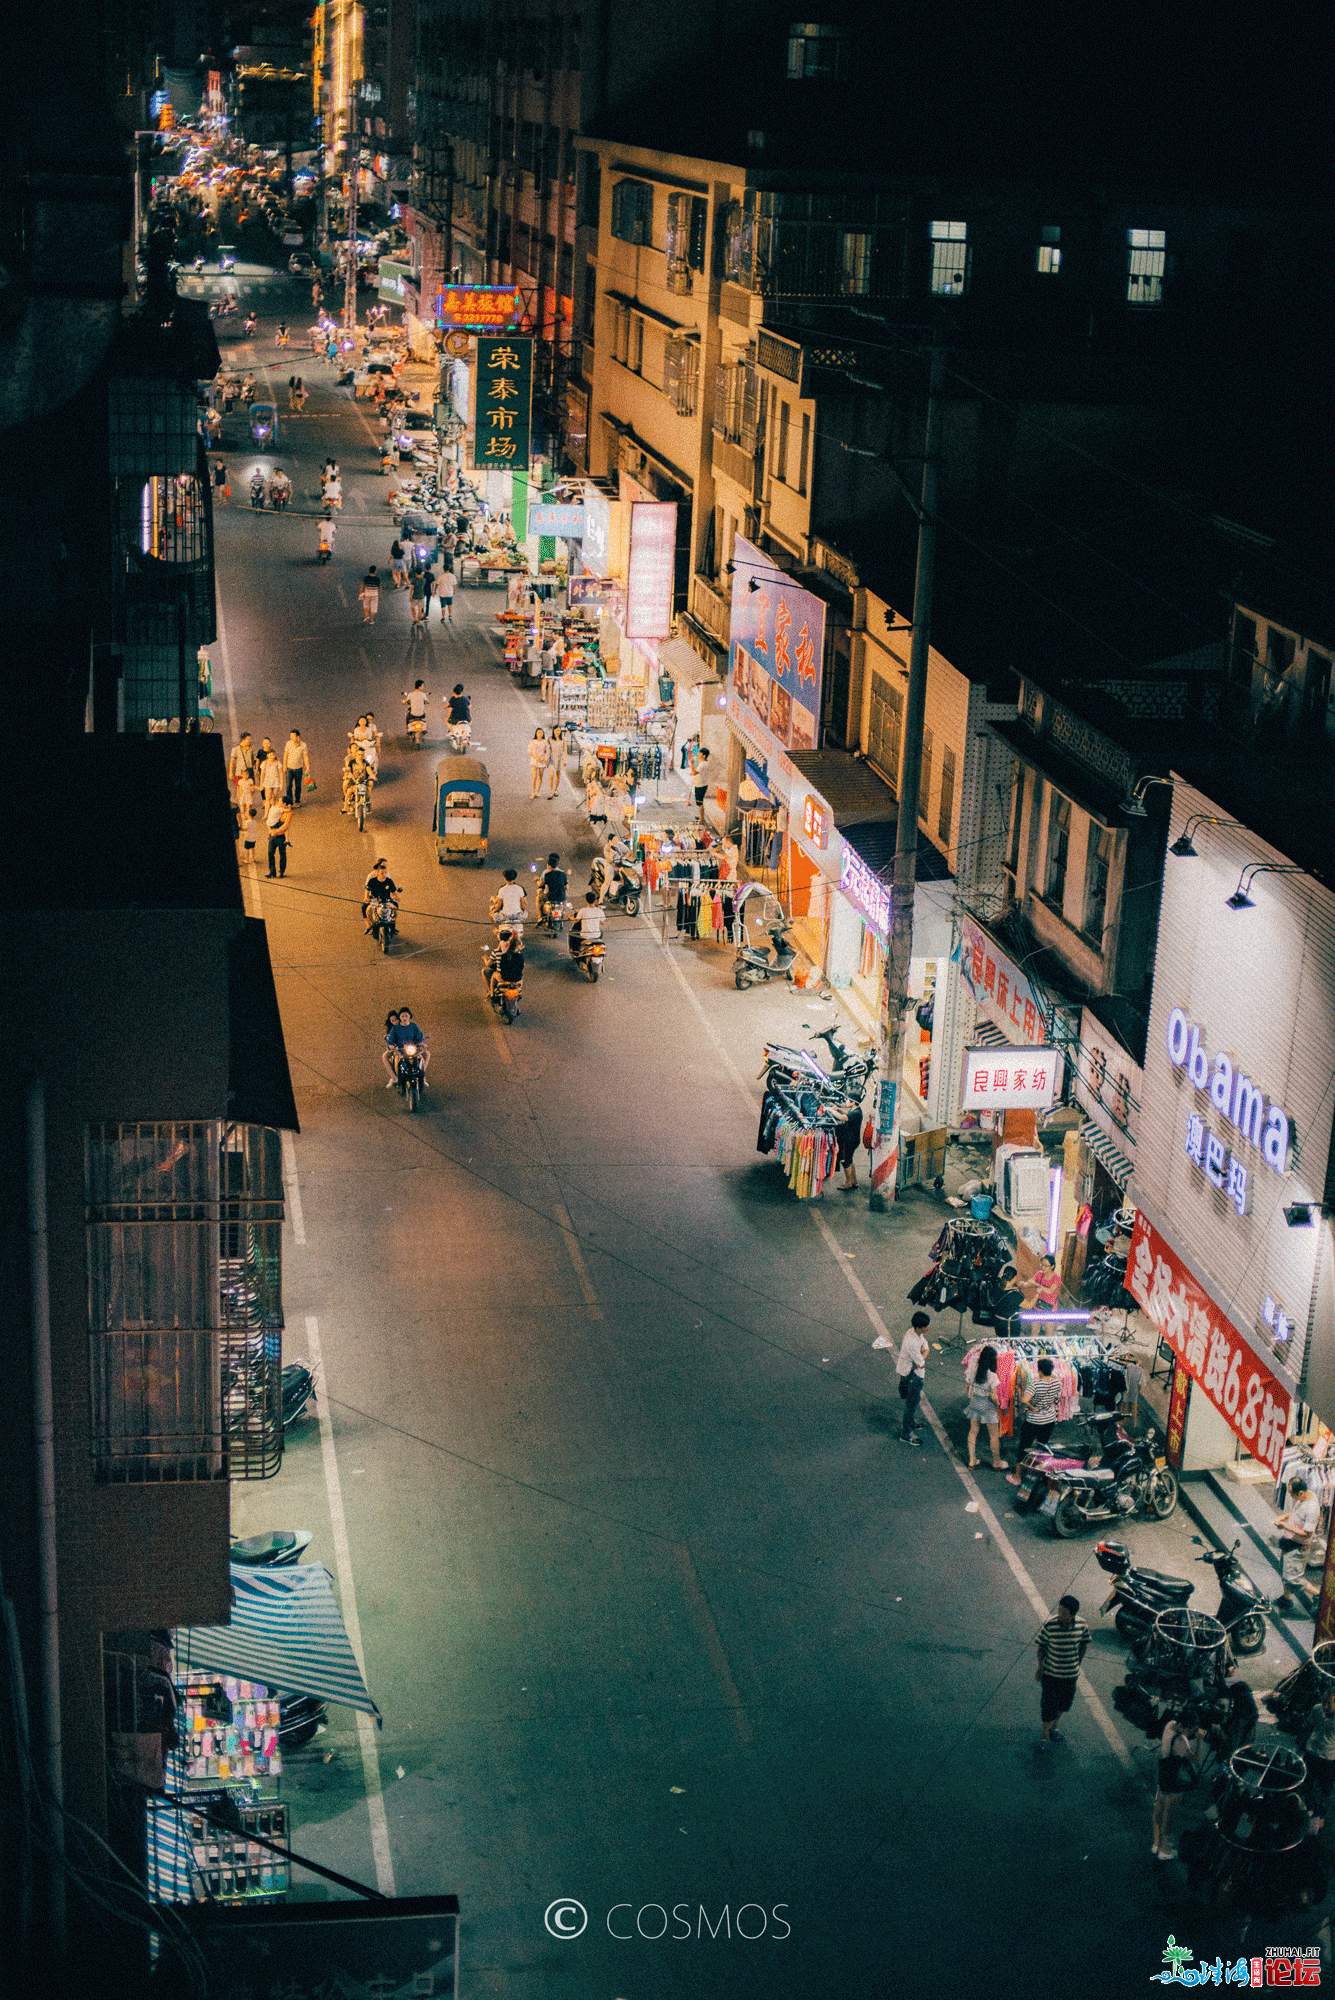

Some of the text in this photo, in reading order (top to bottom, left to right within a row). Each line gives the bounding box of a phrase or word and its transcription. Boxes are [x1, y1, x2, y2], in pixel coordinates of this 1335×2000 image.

[485, 346, 520, 459] 荣泰市场
[974, 1069, 1047, 1092] 良興家纺
[1167, 1007, 1288, 1175] Obama
[1185, 1111, 1248, 1215] 澳巴玛
